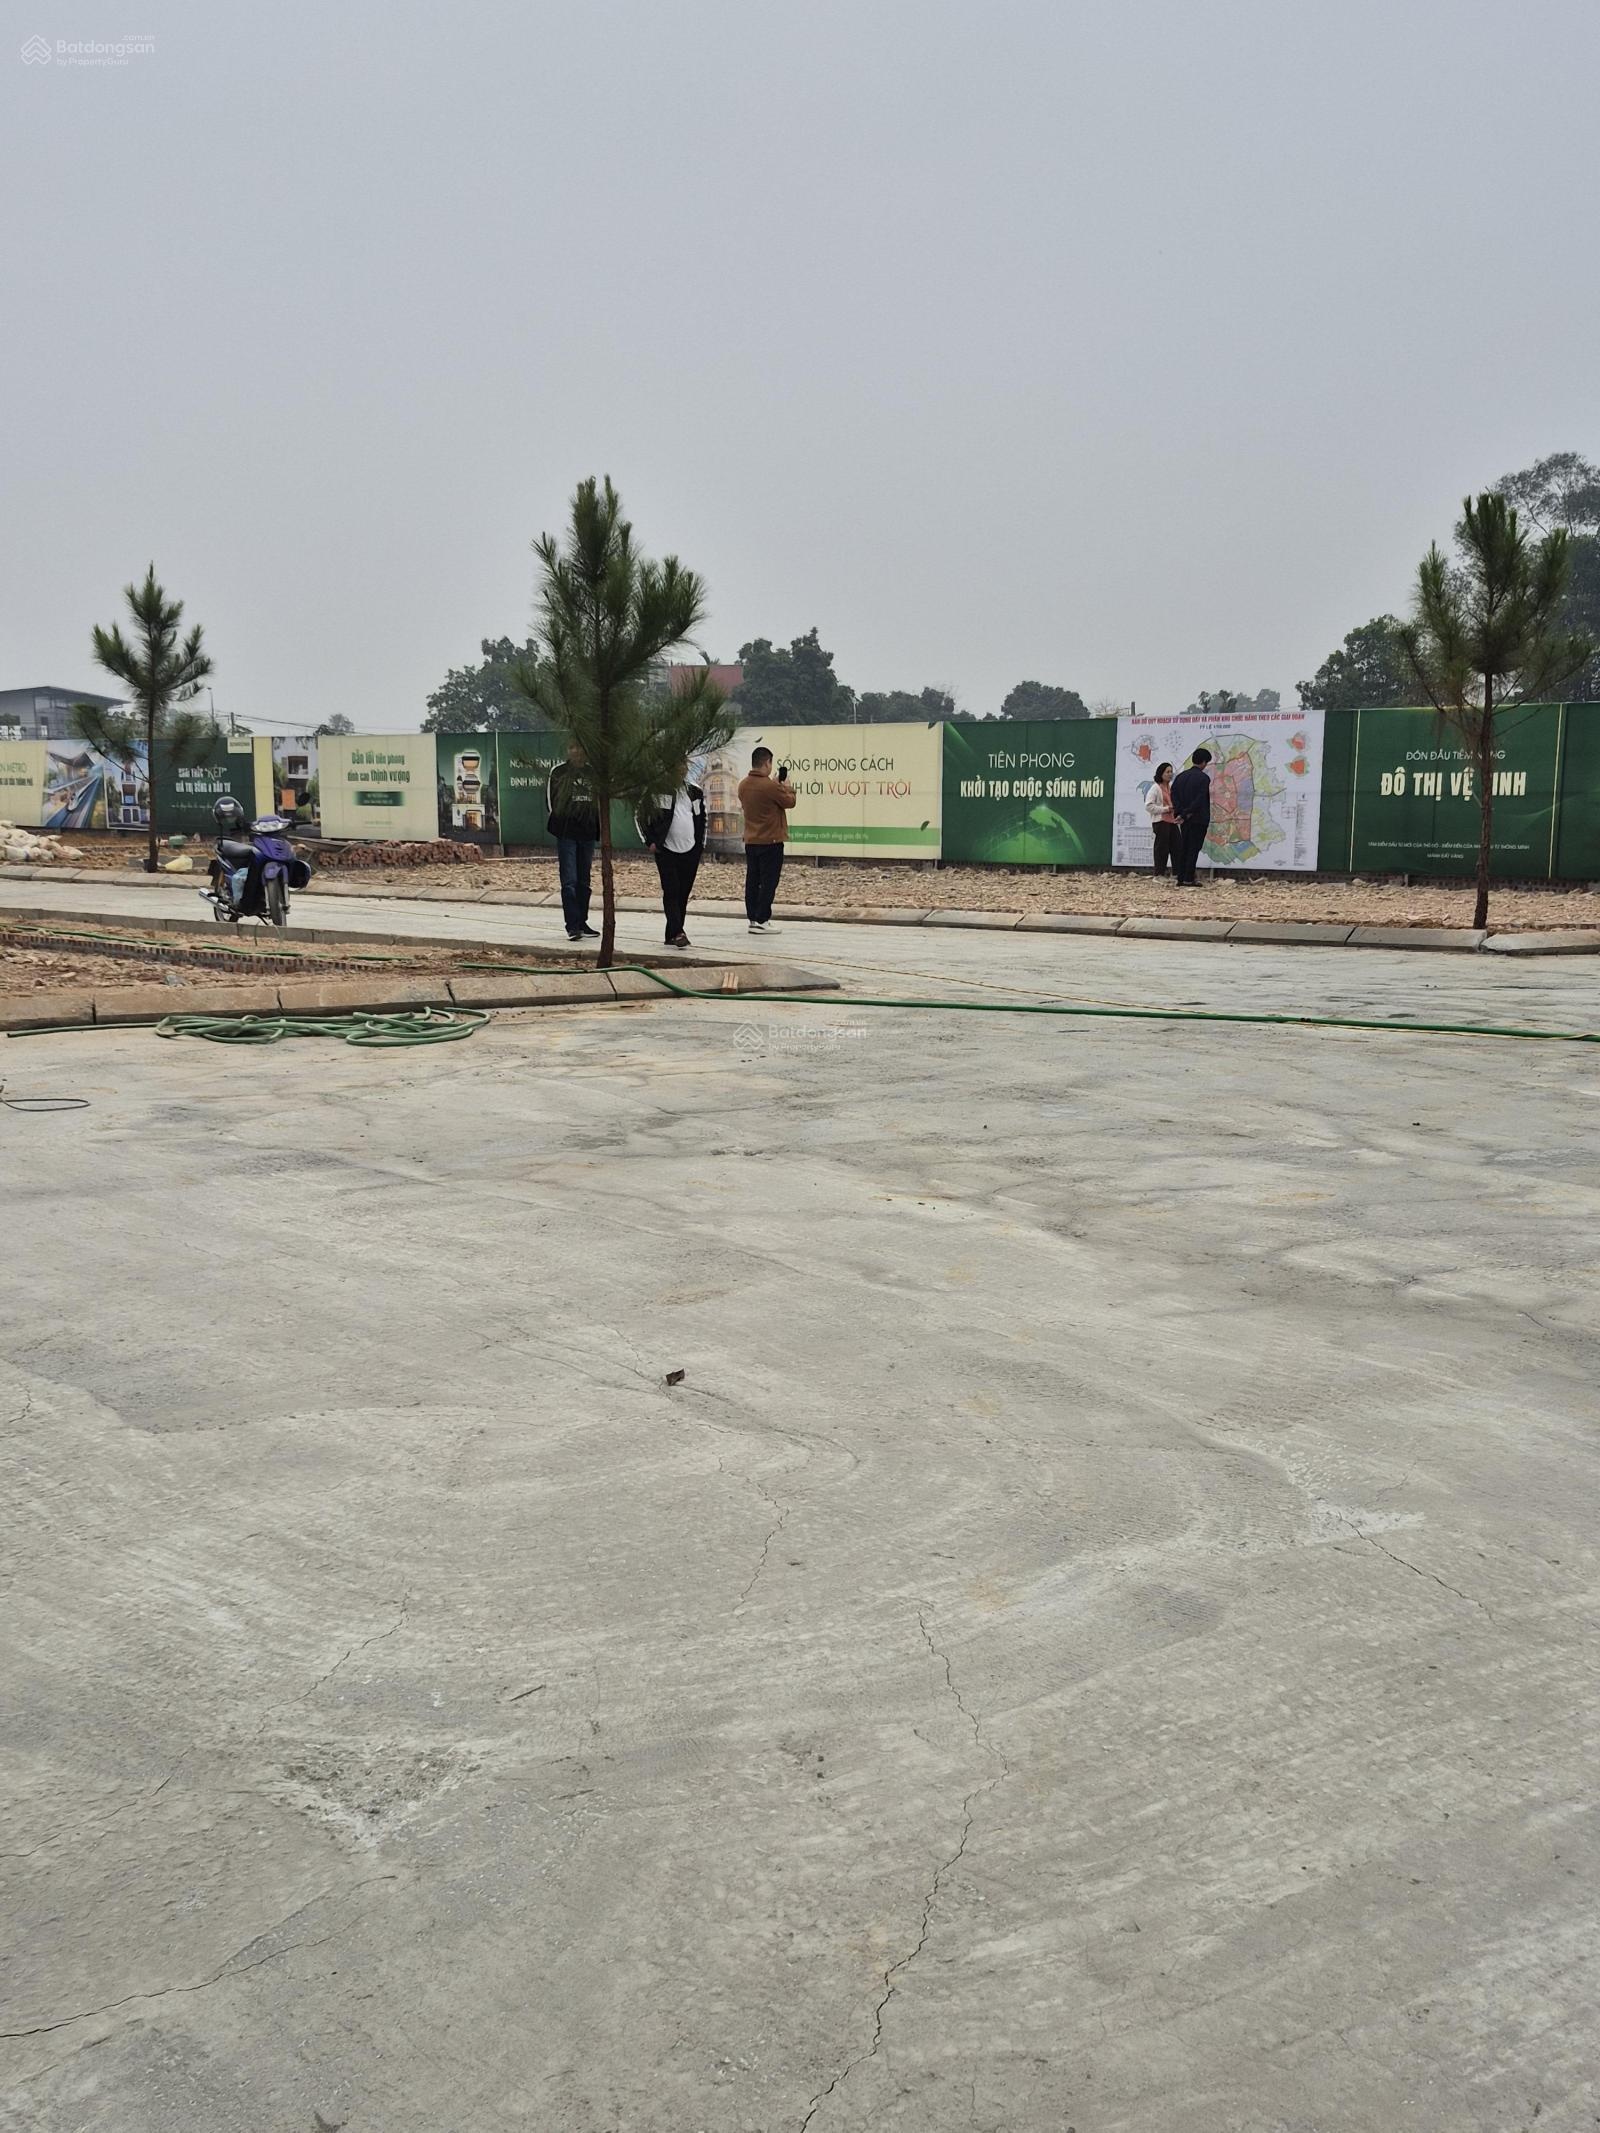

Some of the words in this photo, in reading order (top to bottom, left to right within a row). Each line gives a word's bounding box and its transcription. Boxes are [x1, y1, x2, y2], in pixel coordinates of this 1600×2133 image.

[777, 754, 810, 772] SỐNG
[814, 757, 857, 772] PHONG
[860, 754, 894, 772] CÁCH
[988, 750, 1016, 769] TIÊN
[1020, 752, 1076, 769] PHONG
[1430, 748, 1450, 761] ĐẦU
[806, 779, 824, 796] LỜI
[828, 781, 870, 798] VƯỢT
[876, 779, 912, 799] TRỘI
[960, 774, 985, 798] KHỞI
[989, 780, 1009, 801] TẠO
[1012, 776, 1042, 801] CUỘC
[1045, 776, 1077, 798] SỐNG
[1080, 775, 1105, 798] MỚI
[1380, 766, 1406, 796] ĐÔ
[1413, 772, 1443, 801] THỊ
[1450, 766, 1474, 801] VỆ
[1491, 771, 1527, 796] INH
